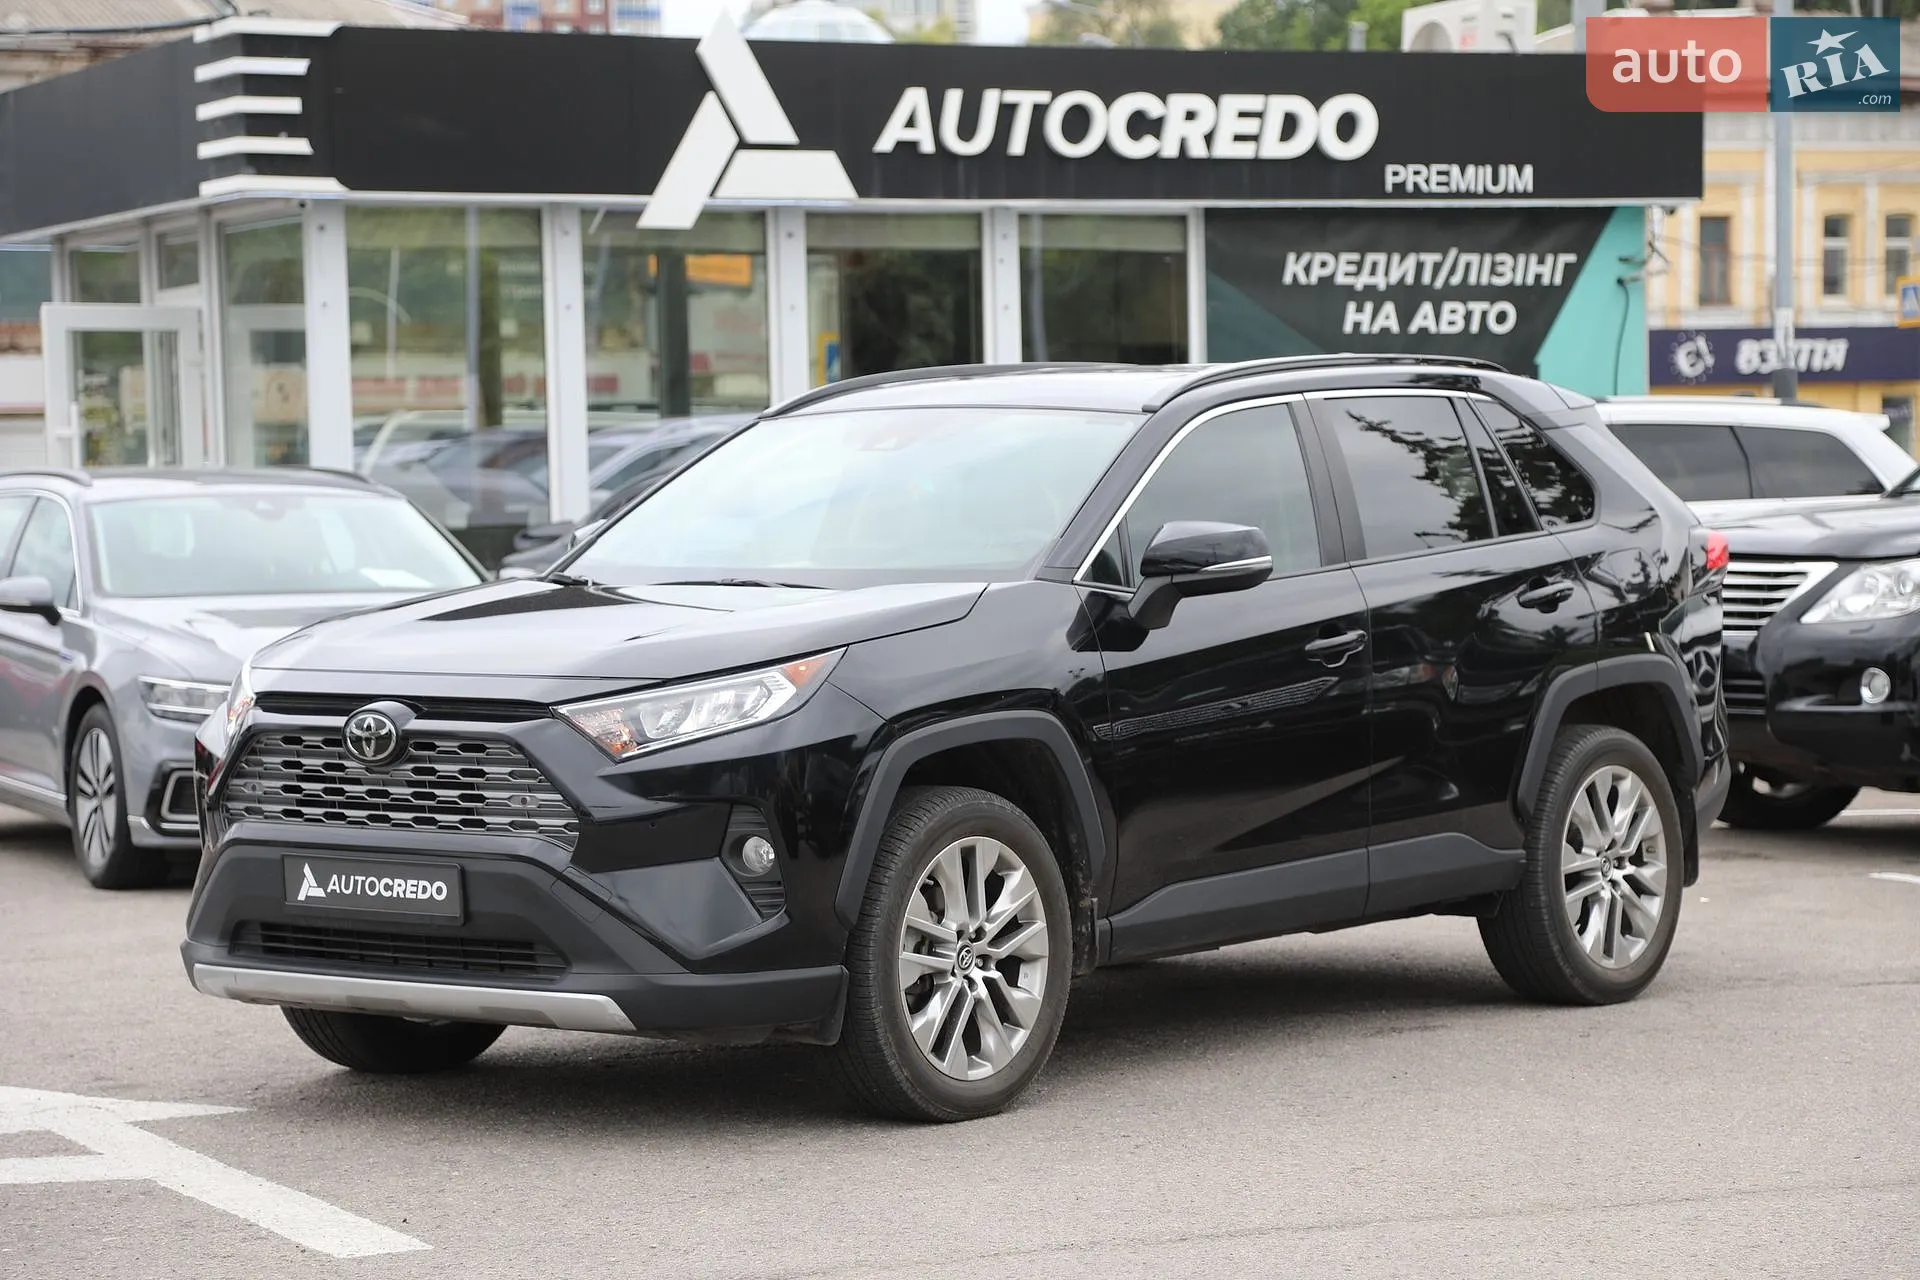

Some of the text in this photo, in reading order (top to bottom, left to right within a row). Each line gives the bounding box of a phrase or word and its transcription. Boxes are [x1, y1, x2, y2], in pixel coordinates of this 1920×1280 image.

[873, 87, 1380, 161] AUTOCREDO
[1384, 163, 1534, 194] PREMIUM
[1282, 247, 1578, 292] КРЕДИТ/ЛІЗІНГ
[1342, 300, 1518, 335] НА АВТО
[327, 874, 448, 901] AUTOCREDO
